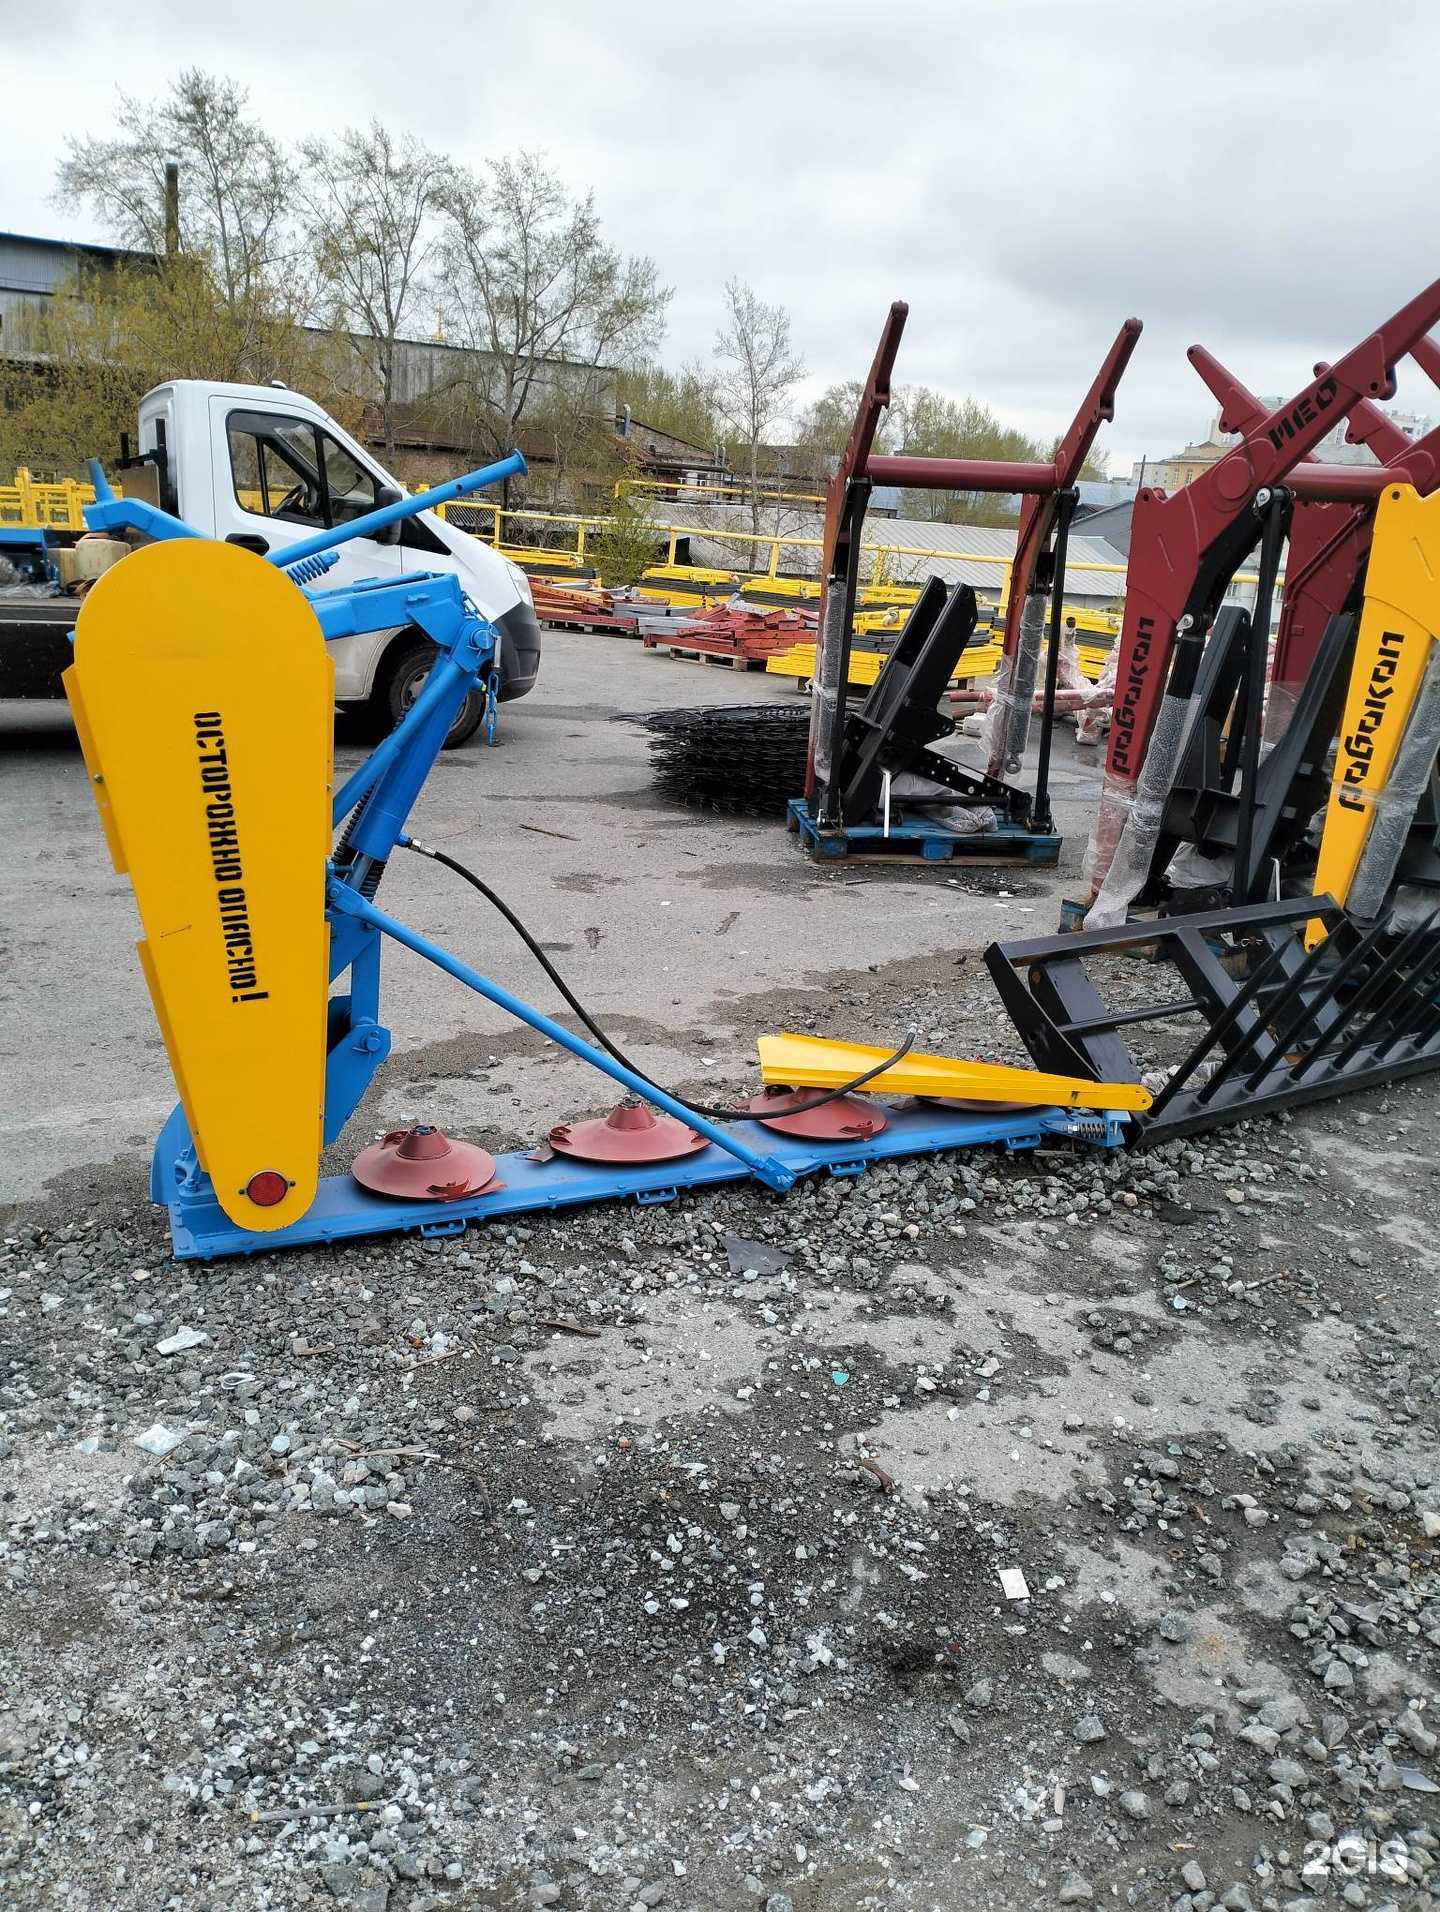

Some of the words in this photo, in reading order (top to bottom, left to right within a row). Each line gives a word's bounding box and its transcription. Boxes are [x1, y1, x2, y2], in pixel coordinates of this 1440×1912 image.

[1268, 376, 1338, 451] NEO
[193, 711, 243, 882] ОСТОРОЖНО
[218, 887, 270, 1003] ОПАСНО!
